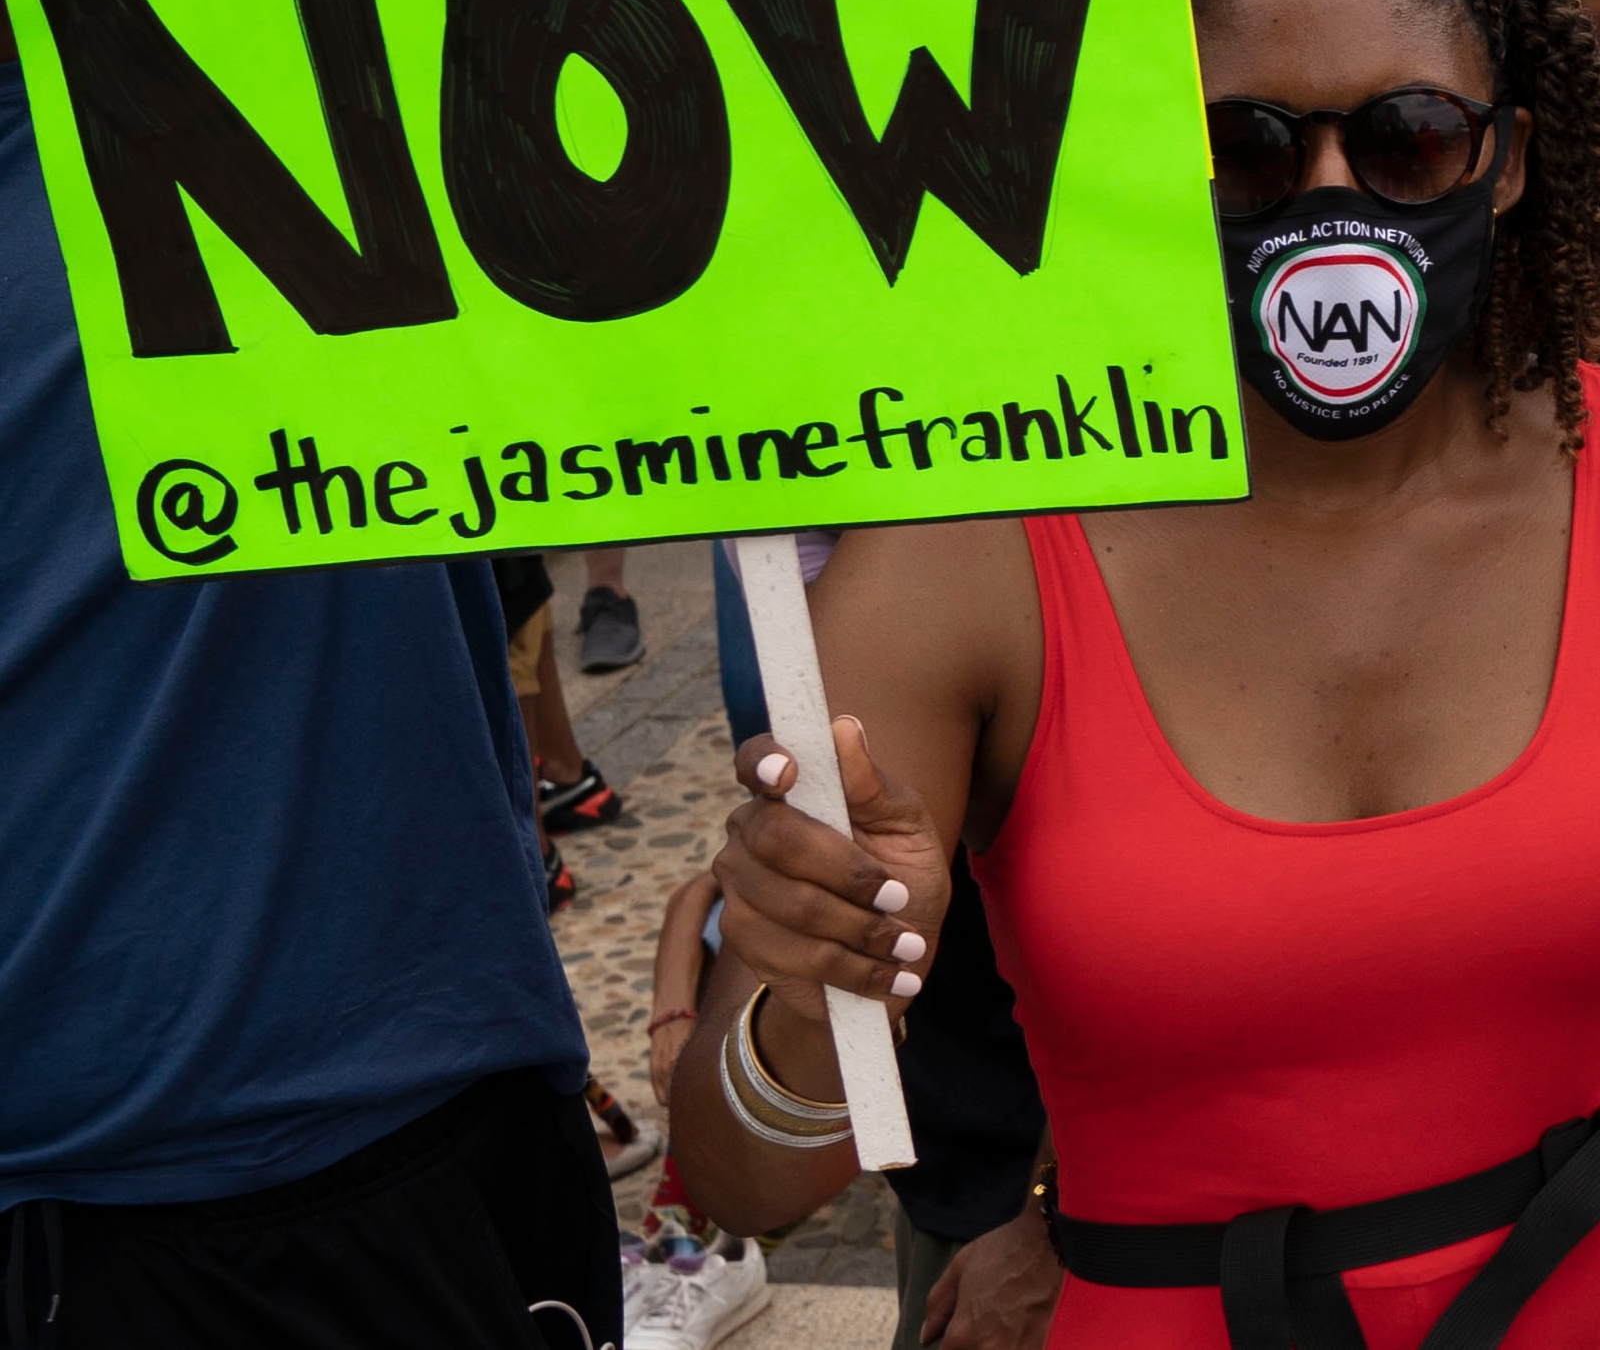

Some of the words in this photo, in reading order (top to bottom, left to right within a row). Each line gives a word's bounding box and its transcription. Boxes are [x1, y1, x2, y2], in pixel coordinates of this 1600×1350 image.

[1246, 229, 1308, 274] NATIONAL
[1310, 220, 1371, 238] ACTION
[1374, 227, 1434, 273] NETWORK
[1278, 289, 1401, 353] NAN
[1296, 352, 1349, 368] Founded
[1352, 353, 1379, 367] 1991
[1272, 369, 1287, 390] NO
[1285, 389, 1341, 419] JUSTICE
[1348, 404, 1371, 418] NO
[1372, 372, 1412, 410] PEACE
